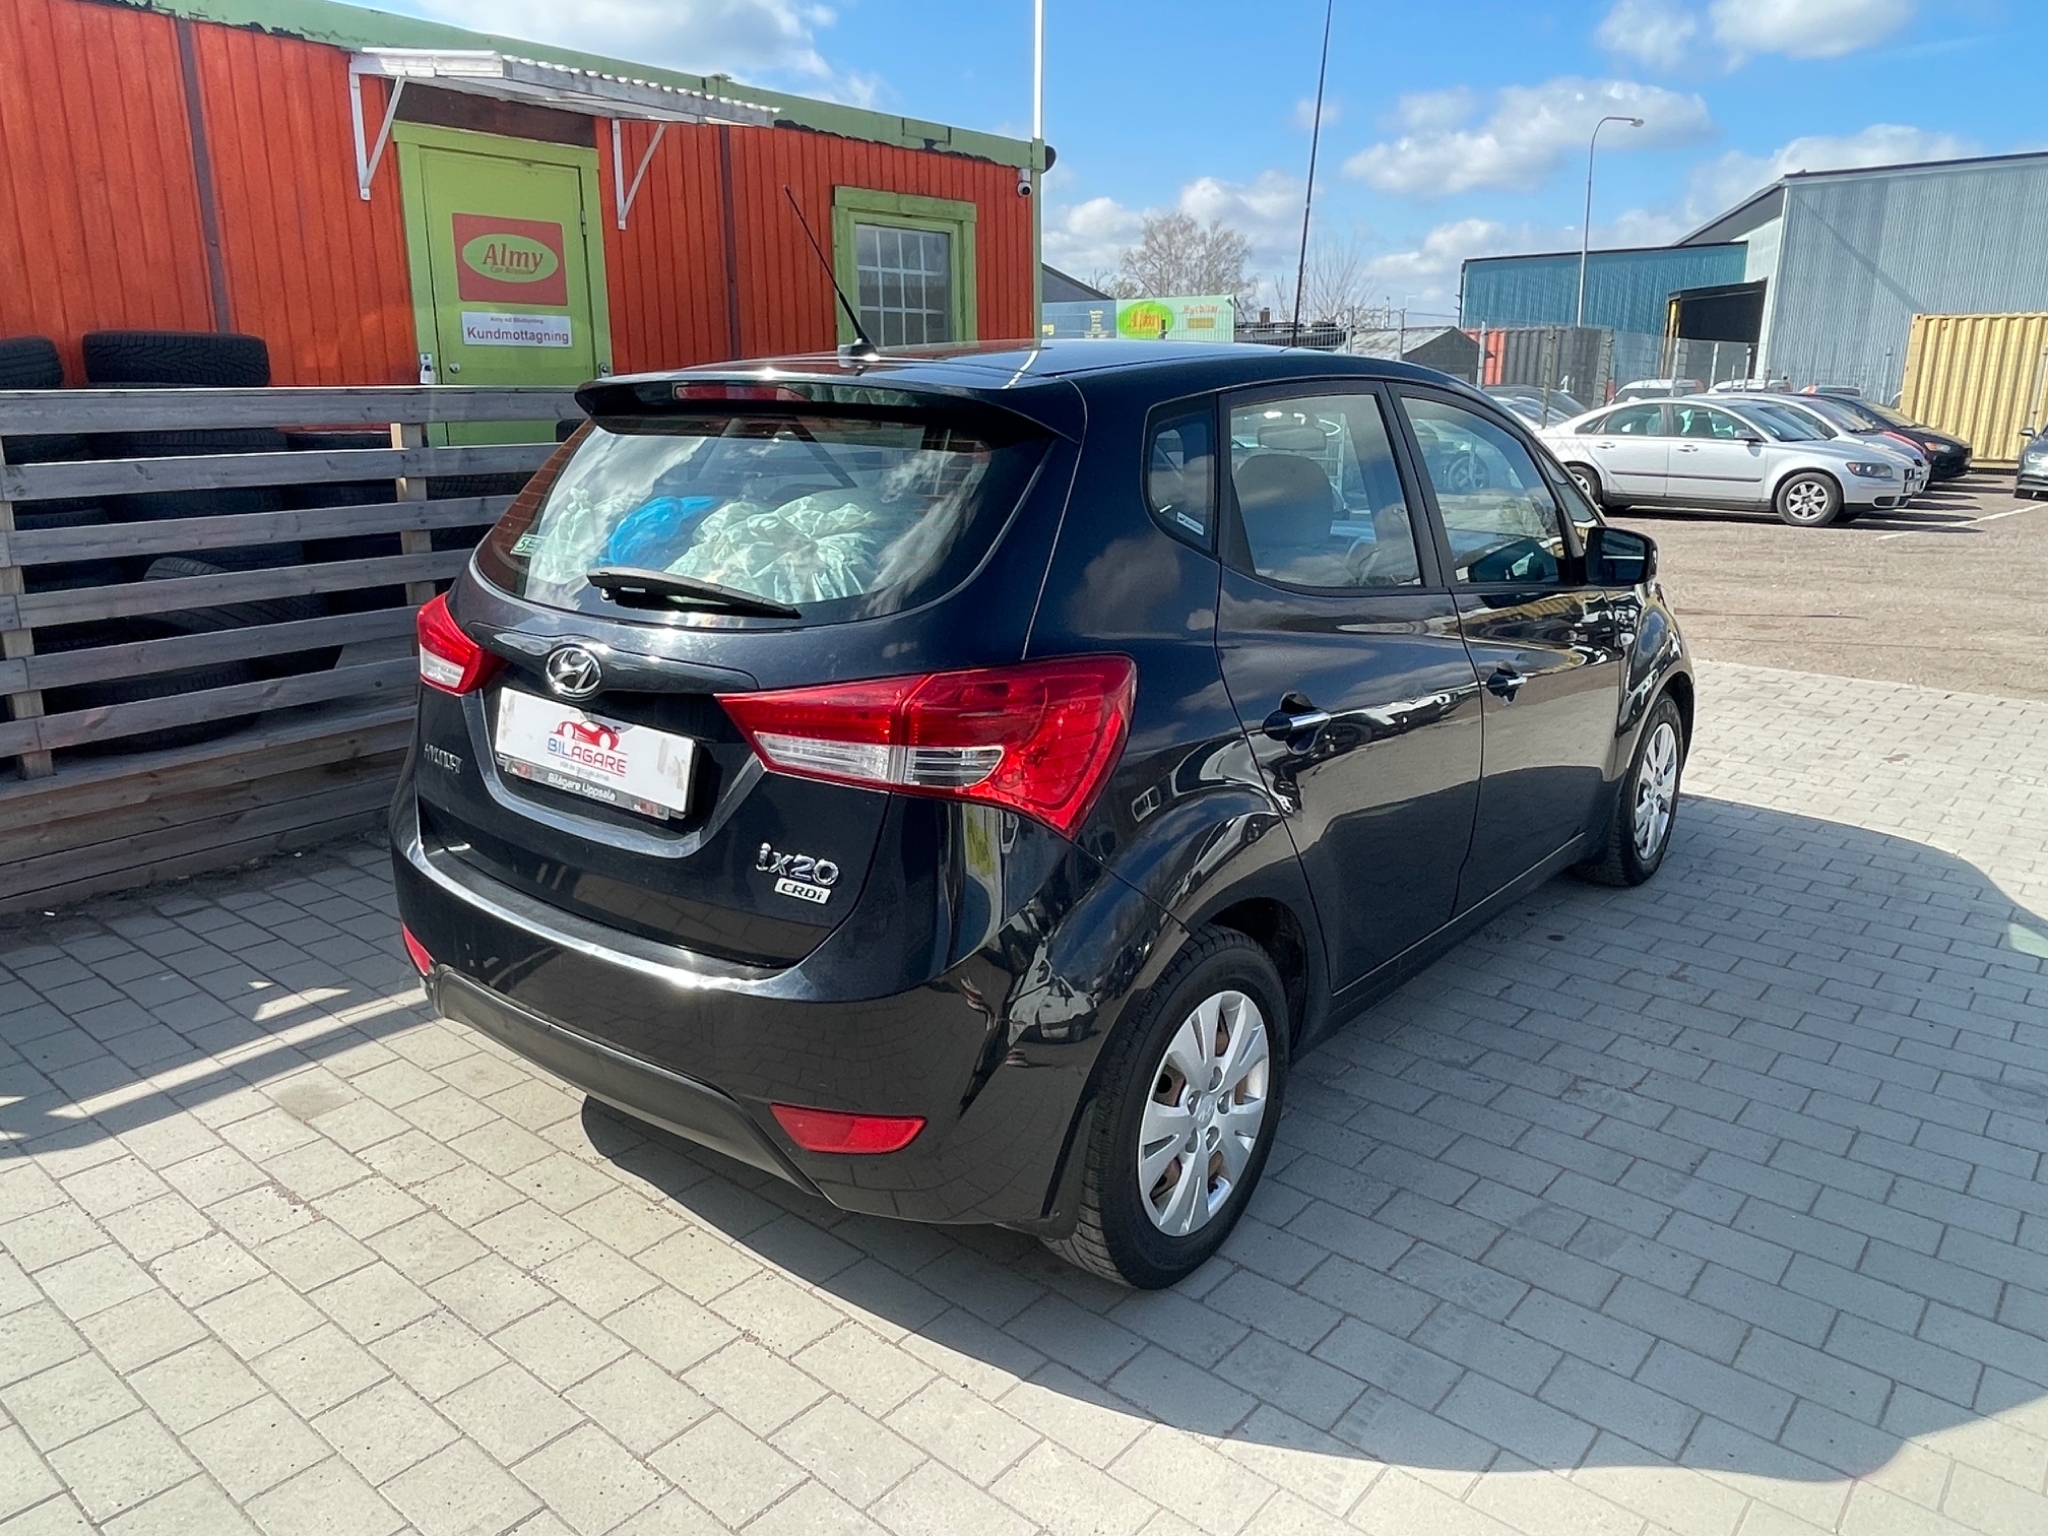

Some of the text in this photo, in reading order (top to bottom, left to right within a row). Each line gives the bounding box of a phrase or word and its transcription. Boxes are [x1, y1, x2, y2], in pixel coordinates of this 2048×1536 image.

[482, 243, 543, 274] Almy
[466, 326, 569, 344] Kundmottagning
[582, 781, 616, 802] Uppsala
[755, 842, 840, 886] ix20
[781, 882, 824, 901] CRDi
